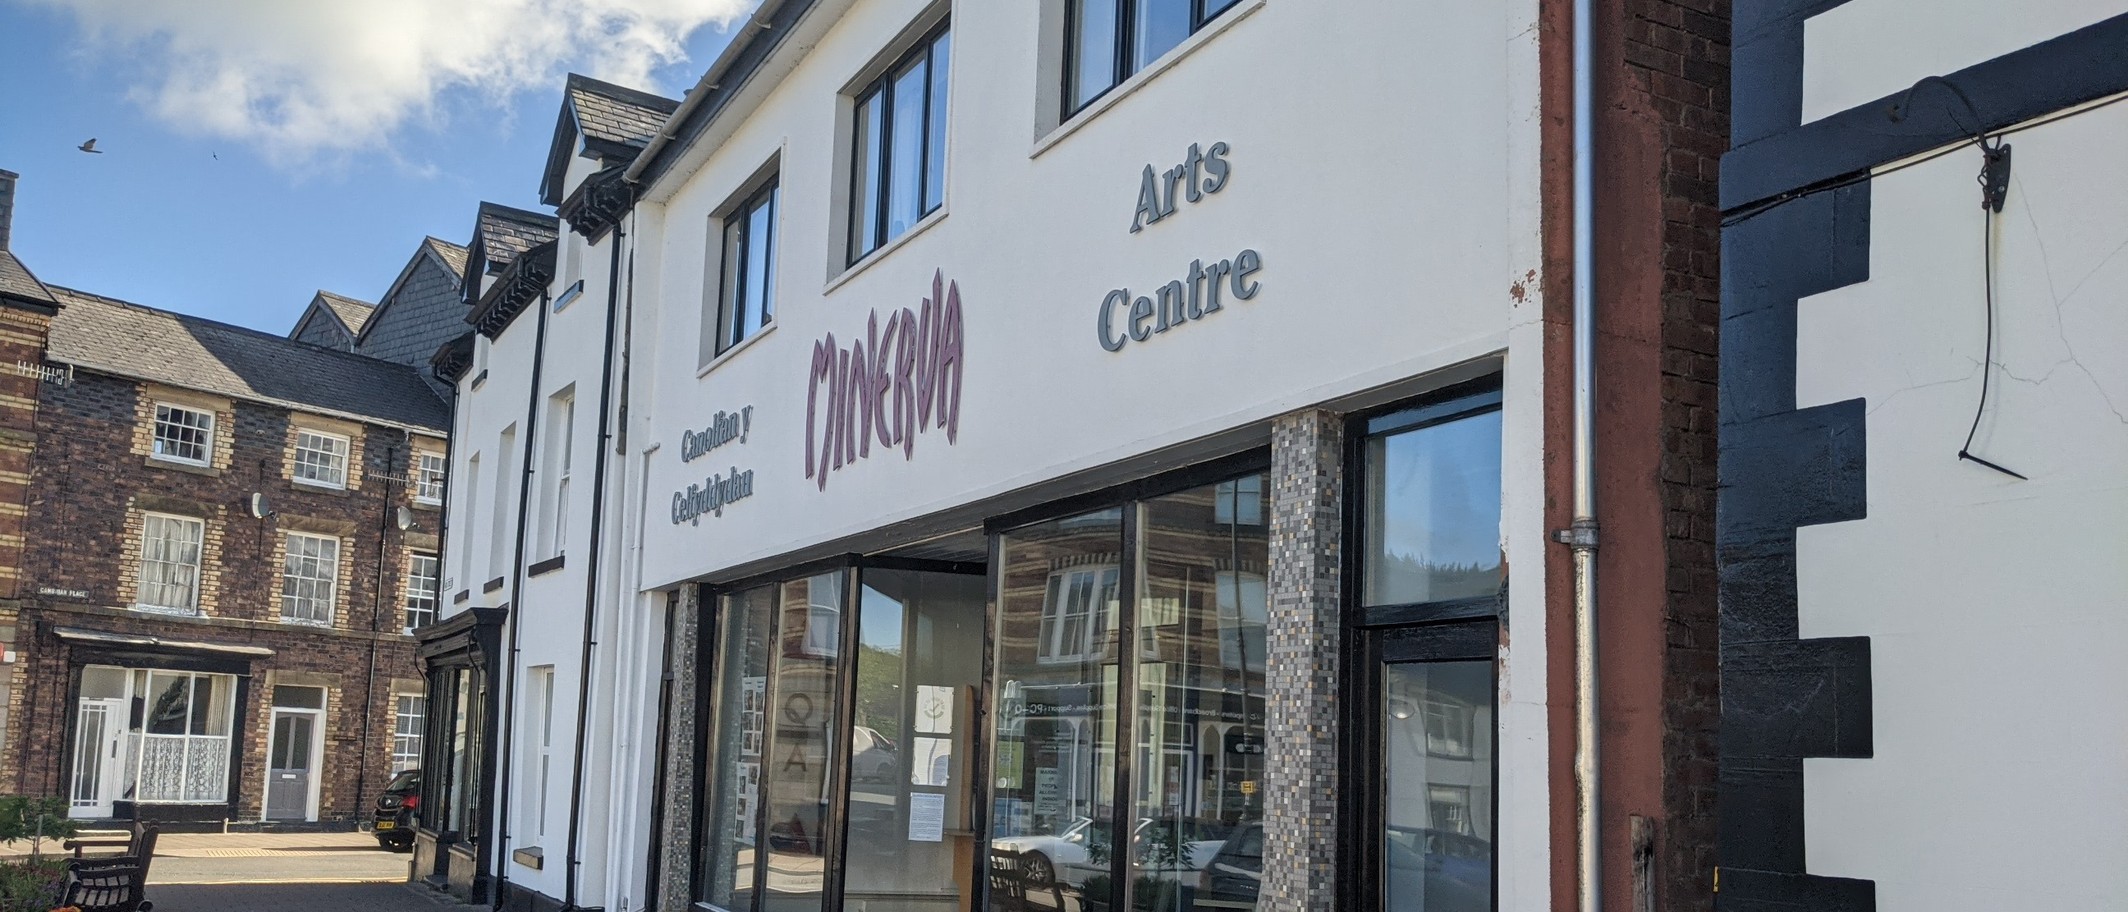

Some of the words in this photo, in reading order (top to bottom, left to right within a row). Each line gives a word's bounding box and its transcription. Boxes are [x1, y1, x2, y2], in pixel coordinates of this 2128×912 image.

[1130, 142, 1229, 234] Arts
[1098, 249, 1260, 352] Centre
[806, 267, 964, 492] MINERVA
[681, 409, 739, 463] Canolfan
[740, 405, 753, 444] y
[671, 466, 753, 527] Celfyddydau
